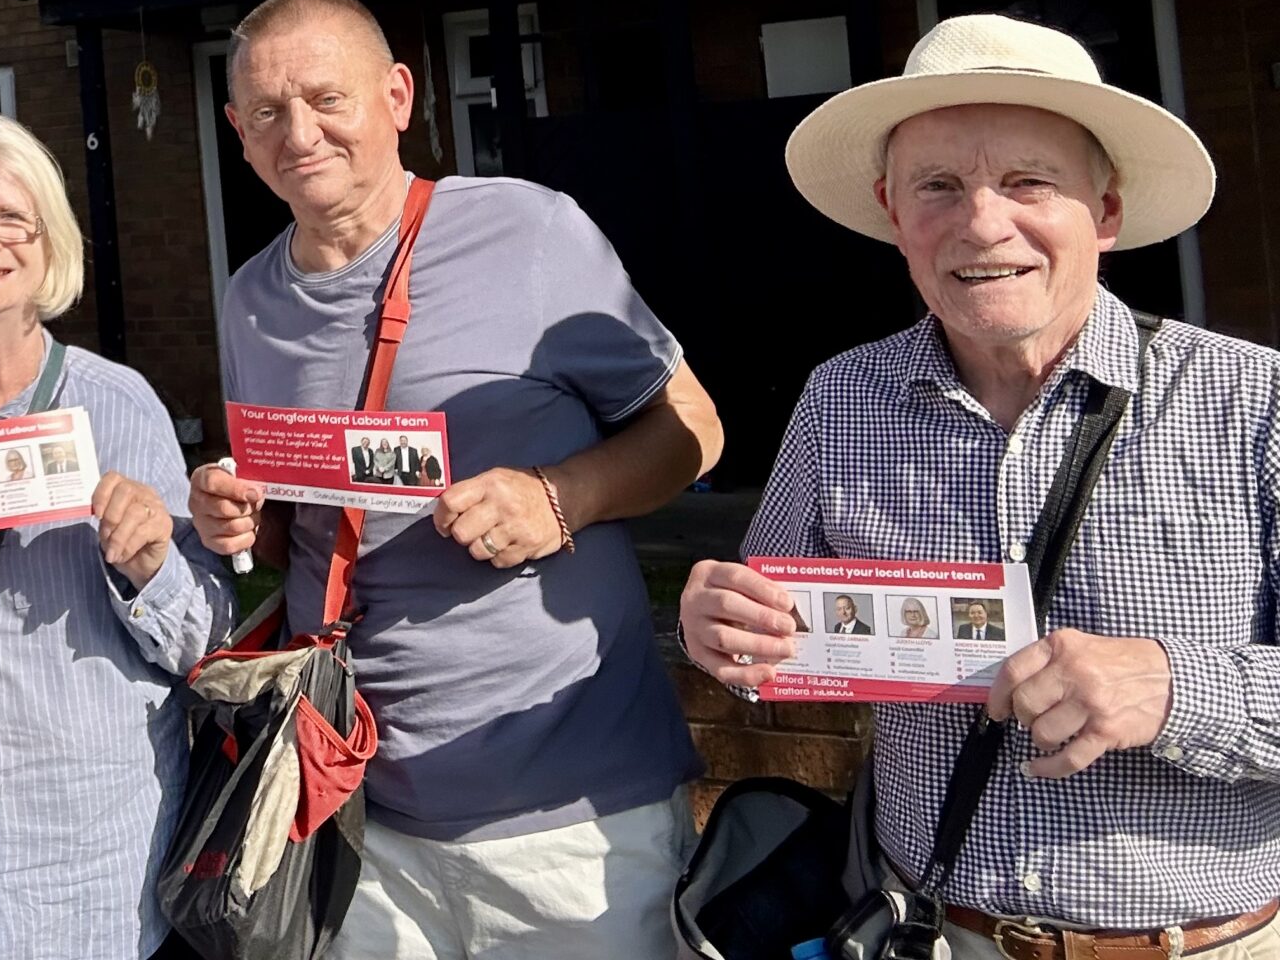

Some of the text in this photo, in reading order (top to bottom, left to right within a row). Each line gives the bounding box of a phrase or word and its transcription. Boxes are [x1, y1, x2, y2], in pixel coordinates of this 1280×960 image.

[86, 132, 99, 150] 6
[241, 408, 429, 427] Your Longford Ward Labour Team
[5, 424, 37, 436] Labour
[265, 485, 305, 498] Labour
[312, 490, 346, 504] Standing
[357, 495, 369, 505] for
[370, 496, 404, 511] Longford
[761, 563, 986, 581] How to contact your local Labour team
[773, 674, 850, 688] rafford Labour
